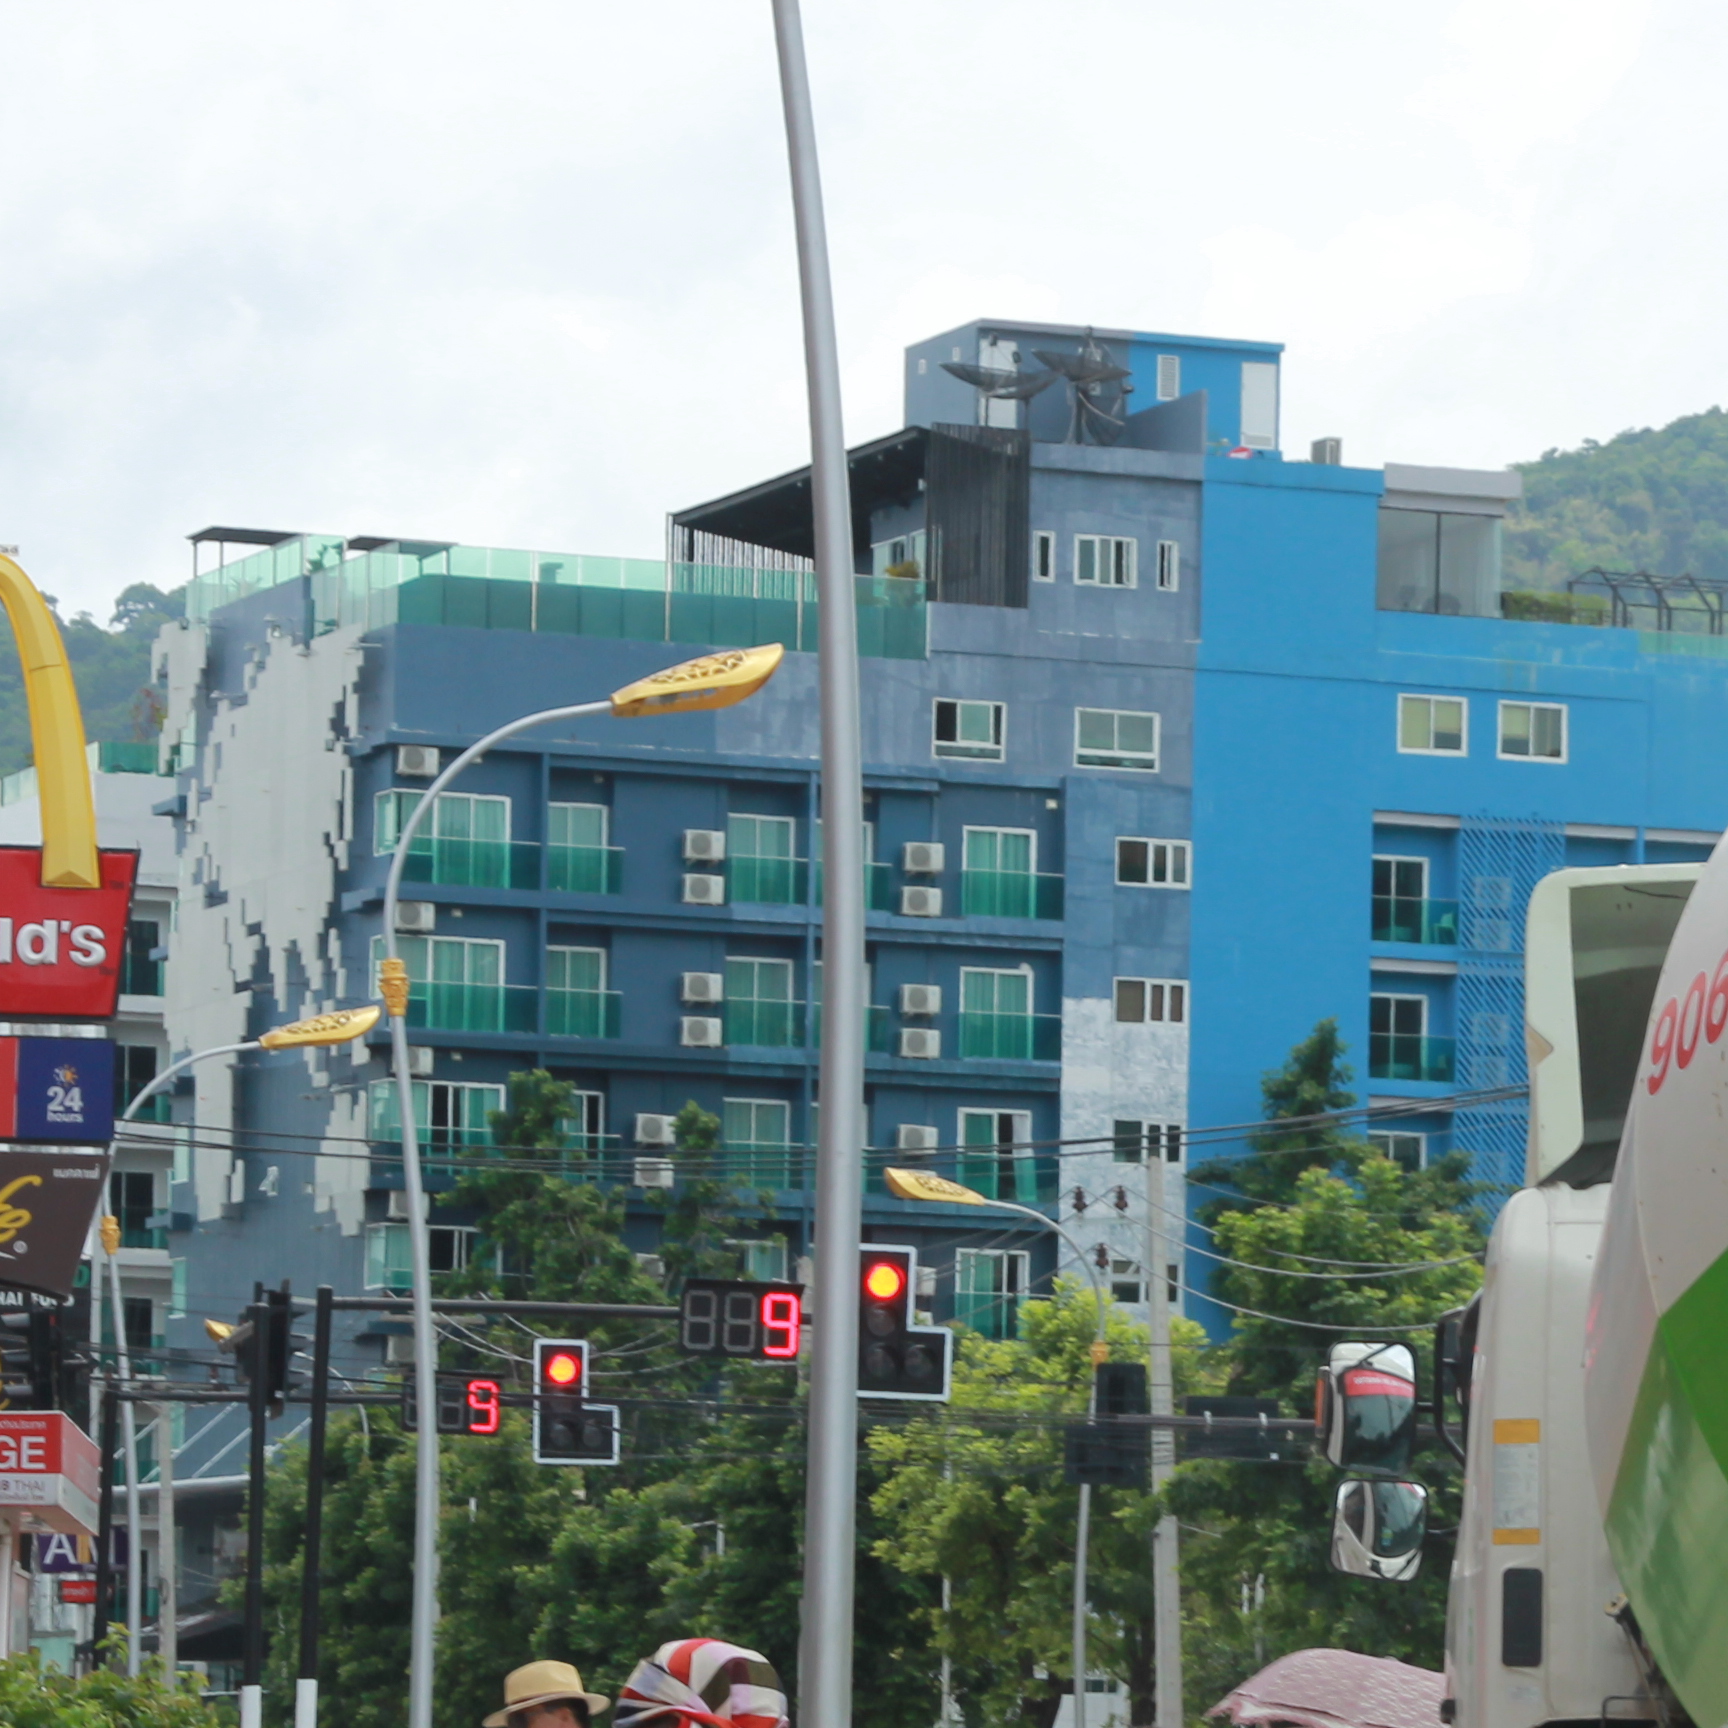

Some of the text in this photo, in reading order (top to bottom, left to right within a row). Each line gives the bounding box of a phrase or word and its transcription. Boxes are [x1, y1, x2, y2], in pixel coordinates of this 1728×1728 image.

[47, 1086, 84, 1112] 24
[46, 1111, 84, 1123] hours
[761, 1292, 801, 1356] 9
[467, 1380, 500, 1433] 9
[14, 1479, 45, 1492] THAI
